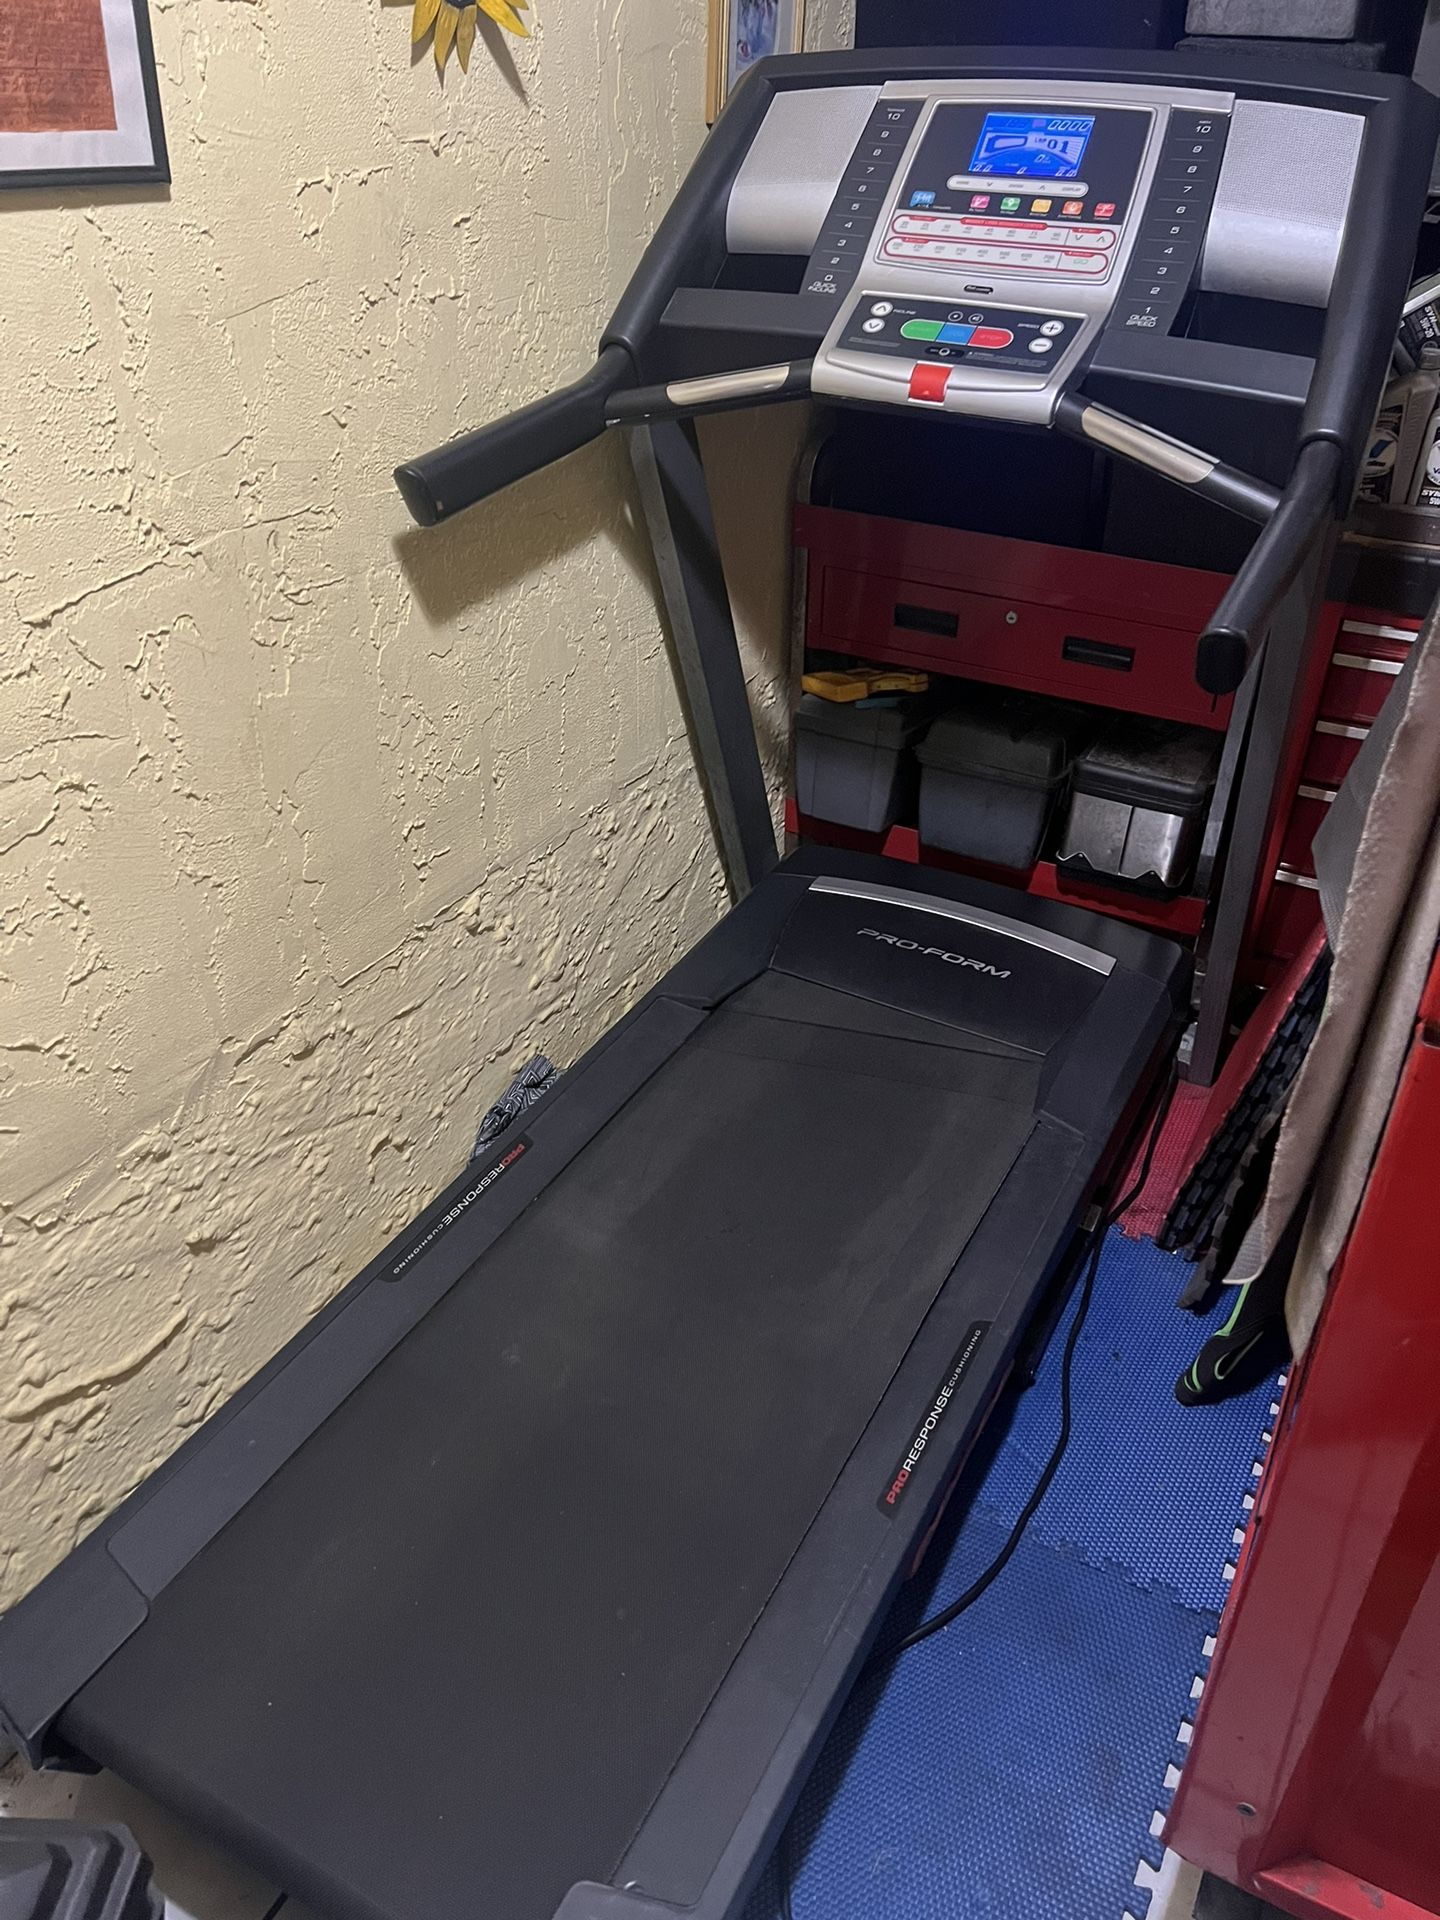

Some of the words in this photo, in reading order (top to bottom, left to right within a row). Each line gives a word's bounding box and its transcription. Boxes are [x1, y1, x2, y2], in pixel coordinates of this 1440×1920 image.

[887, 112, 901, 121] 10
[1196, 125, 1212, 133] 10
[866, 166, 875, 174] 7
[1183, 185, 1193, 193] 7
[1175, 206, 1187, 214] 6
[1169, 226, 1181, 234] 5
[837, 239, 847, 247] 3
[1156, 267, 1168, 275] 3
[824, 274, 834, 282] 0
[1149, 287, 1161, 295] 2
[1126, 319, 1157, 327] SPEED
[857, 927, 1012, 979] PRO-FORM
[948, 1328, 982, 1388] CUSHIONING
